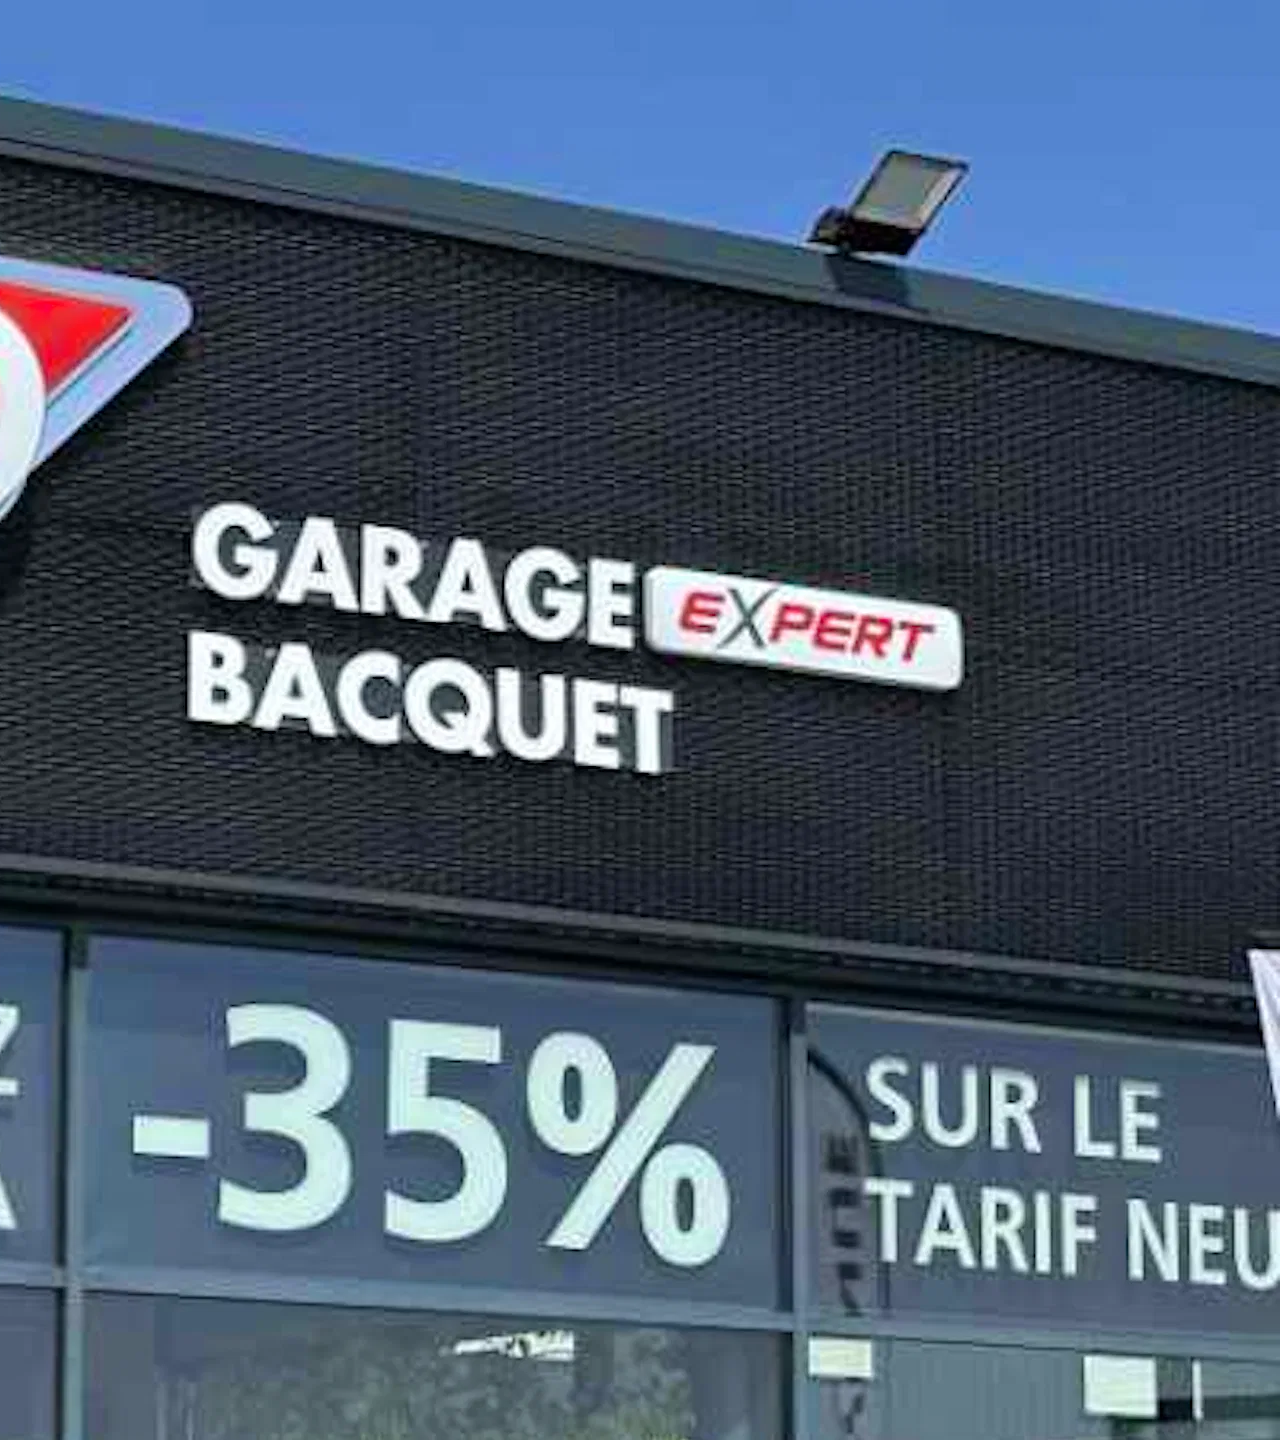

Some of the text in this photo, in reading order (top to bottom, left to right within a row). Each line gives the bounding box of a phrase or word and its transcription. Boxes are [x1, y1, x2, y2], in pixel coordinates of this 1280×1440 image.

[191, 501, 636, 649] GARAGE
[186, 630, 675, 775] BACQUET
[132, 1002, 731, 1267] -35%
[865, 1054, 1163, 1164] SUR LE
[864, 1177, 1280, 1291] TARIF NEU
